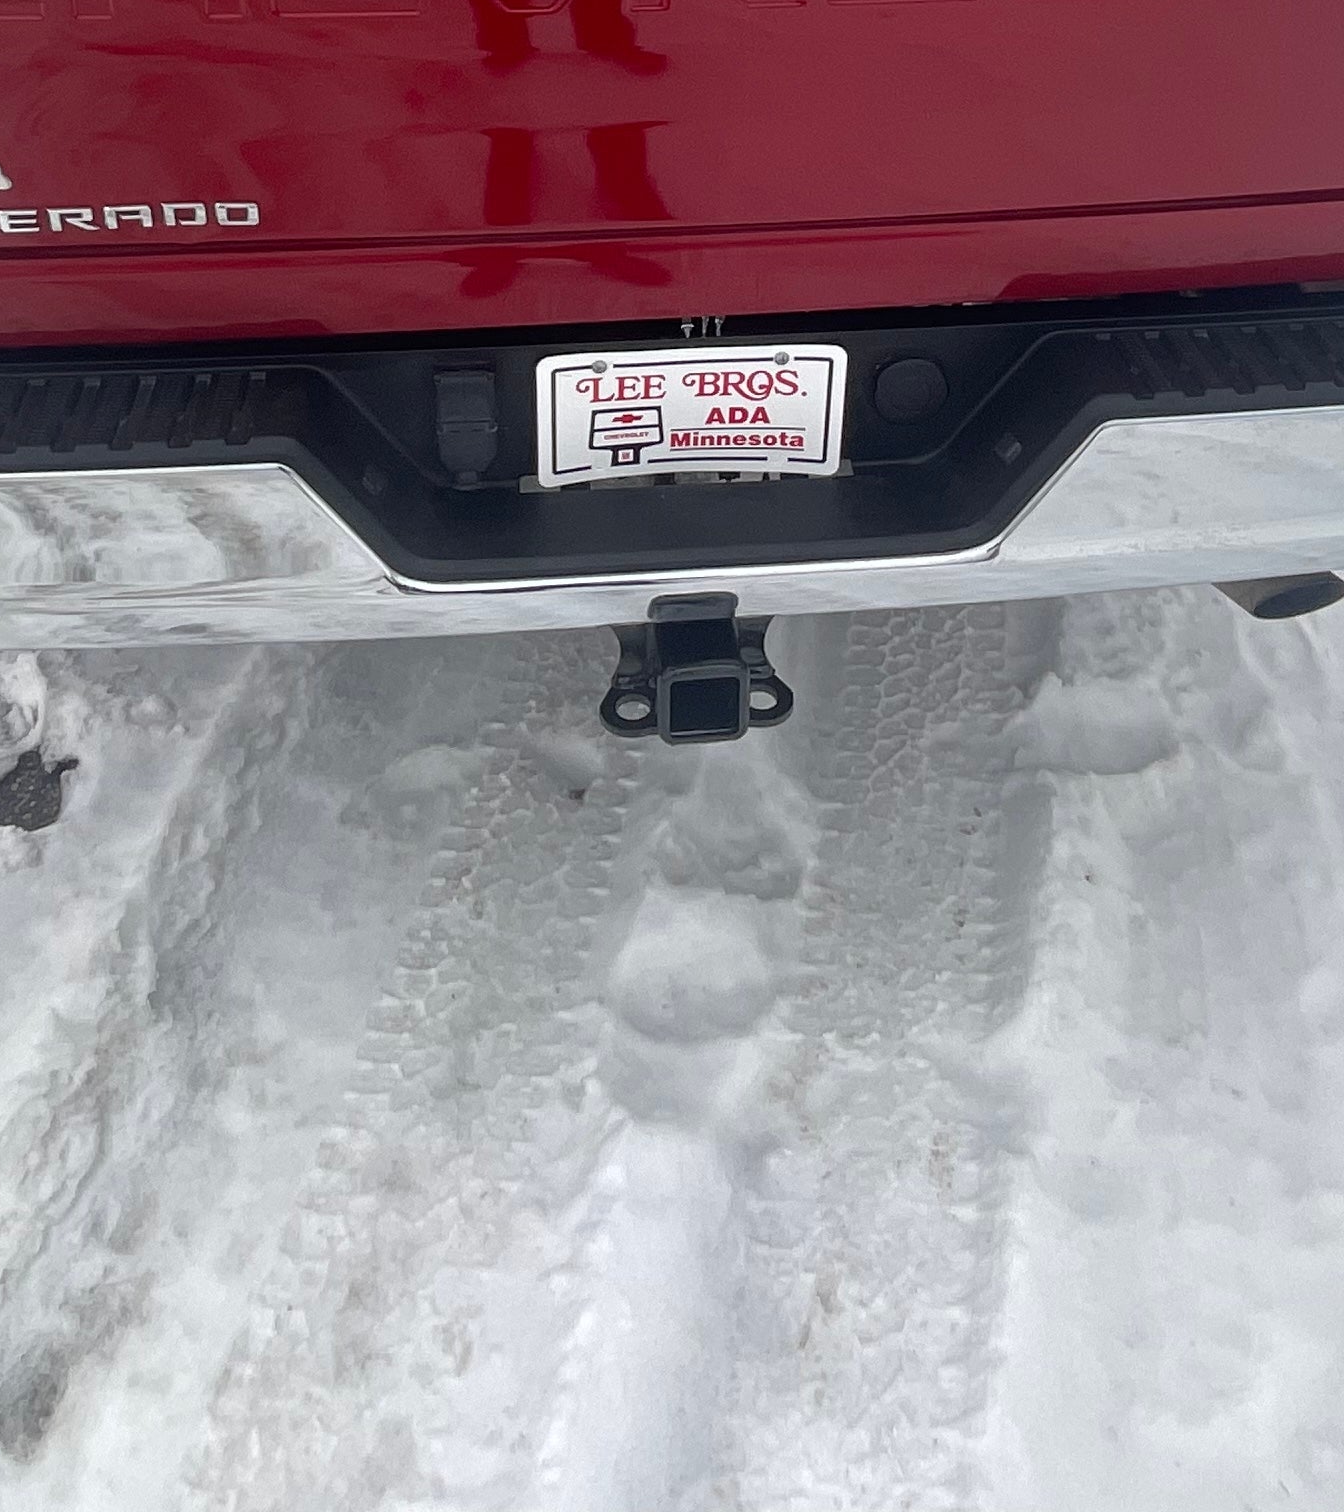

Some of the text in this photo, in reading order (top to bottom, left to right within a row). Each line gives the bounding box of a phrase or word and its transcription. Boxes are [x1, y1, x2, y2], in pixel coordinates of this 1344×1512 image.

[575, 369, 808, 403] LEE BROS.
[705, 406, 771, 425] ADA
[669, 431, 805, 448] Minnesota
